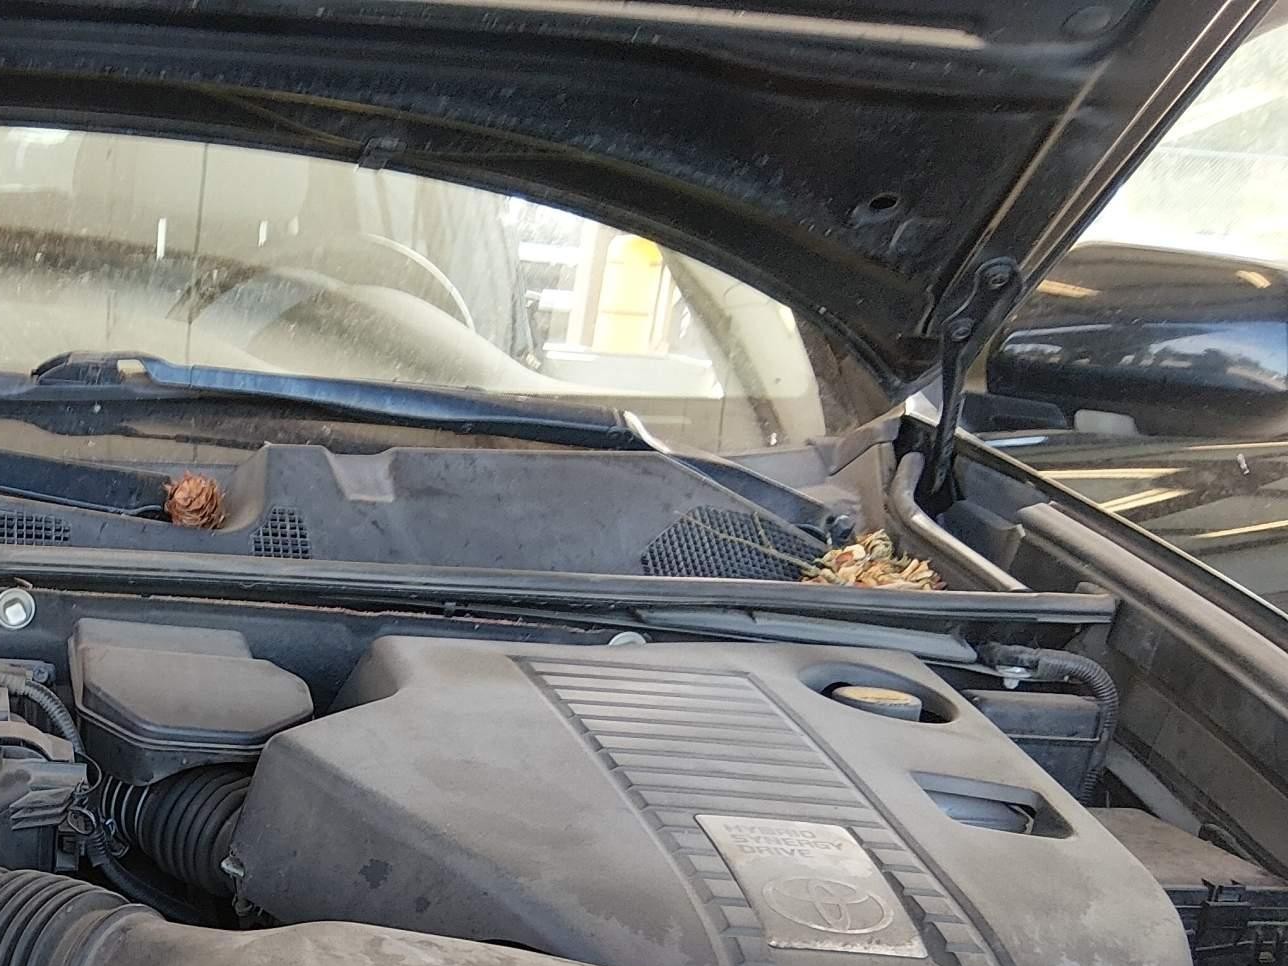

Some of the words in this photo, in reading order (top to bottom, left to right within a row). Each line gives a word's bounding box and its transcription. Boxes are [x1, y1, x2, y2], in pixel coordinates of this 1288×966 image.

[723, 823, 817, 840] HYBRID
[730, 834, 845, 852] SYNERGY
[737, 844, 816, 859] DRIVE
